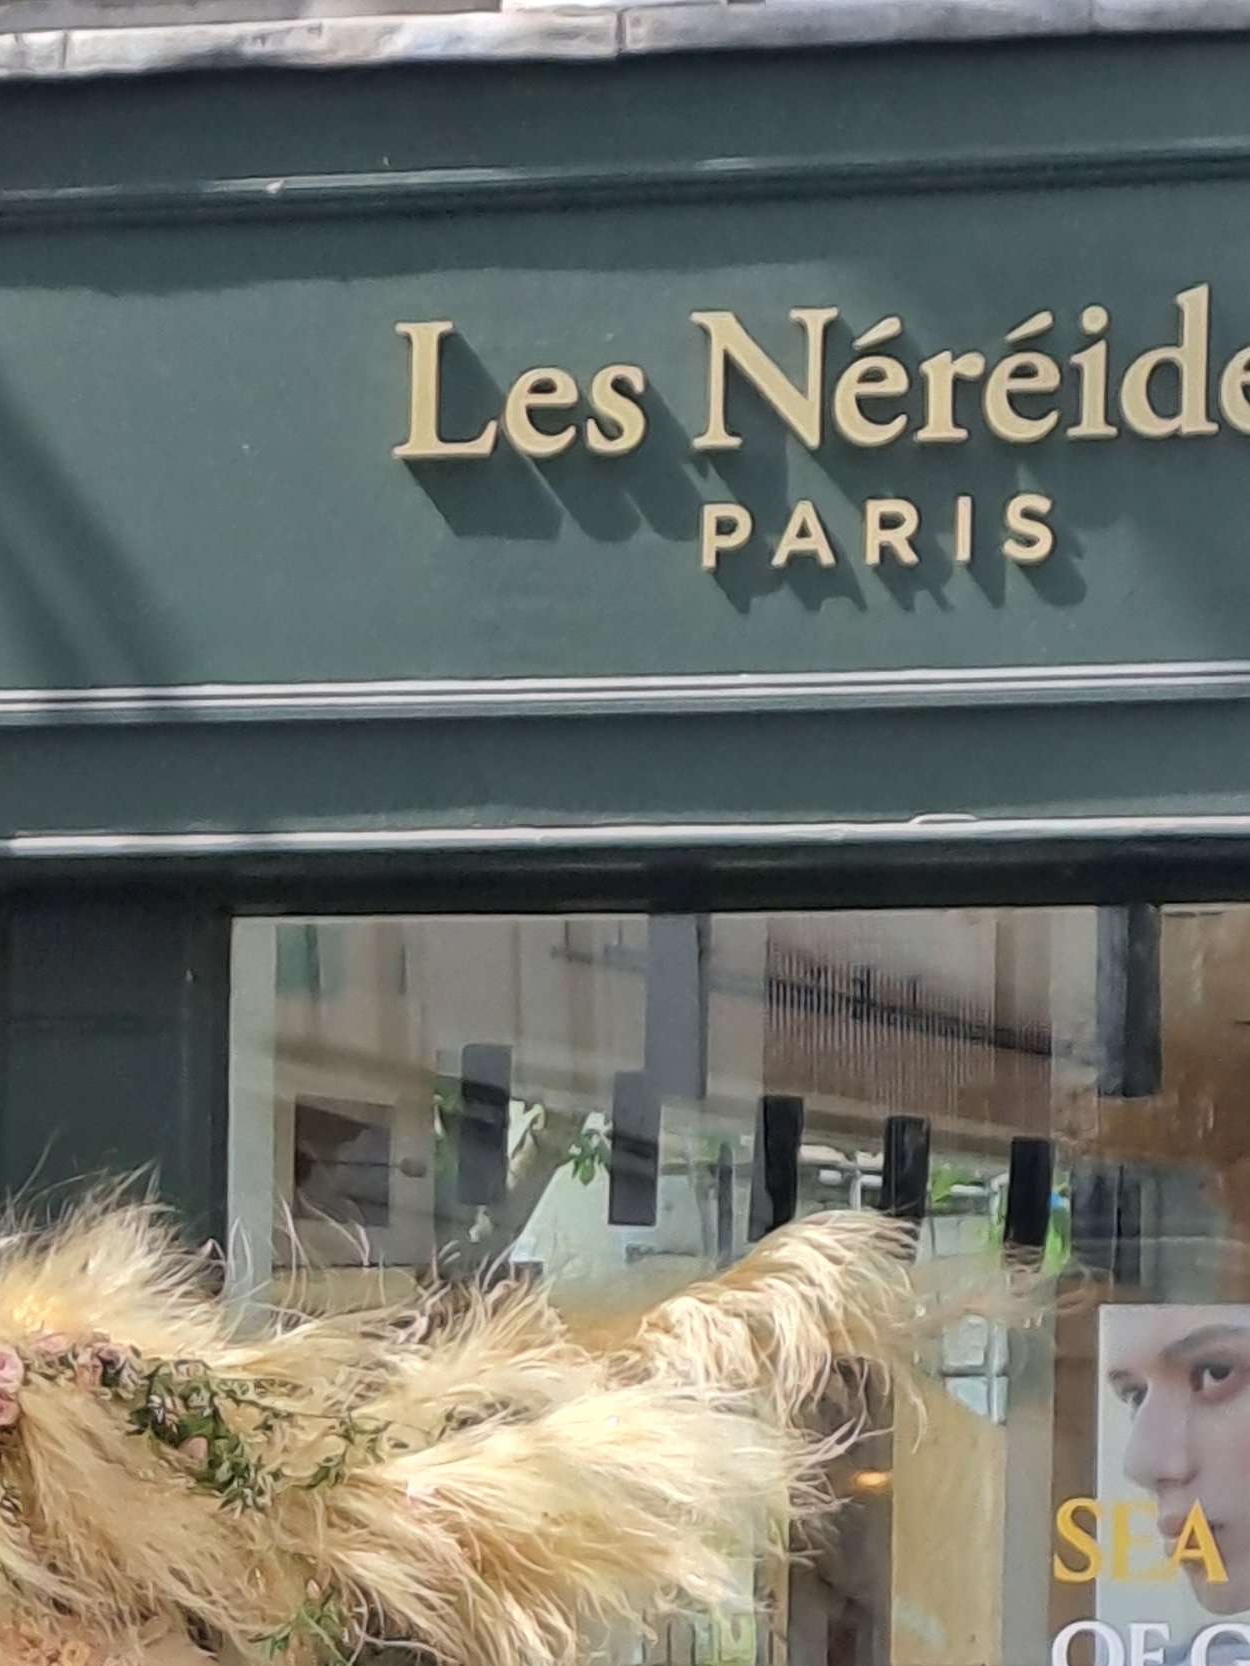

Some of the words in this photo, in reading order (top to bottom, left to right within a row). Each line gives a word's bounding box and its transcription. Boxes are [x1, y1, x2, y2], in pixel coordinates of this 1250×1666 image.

[392, 318, 650, 461] Les
[698, 491, 1056, 573] PARIS
[1052, 1497, 1229, 1583] SEA
